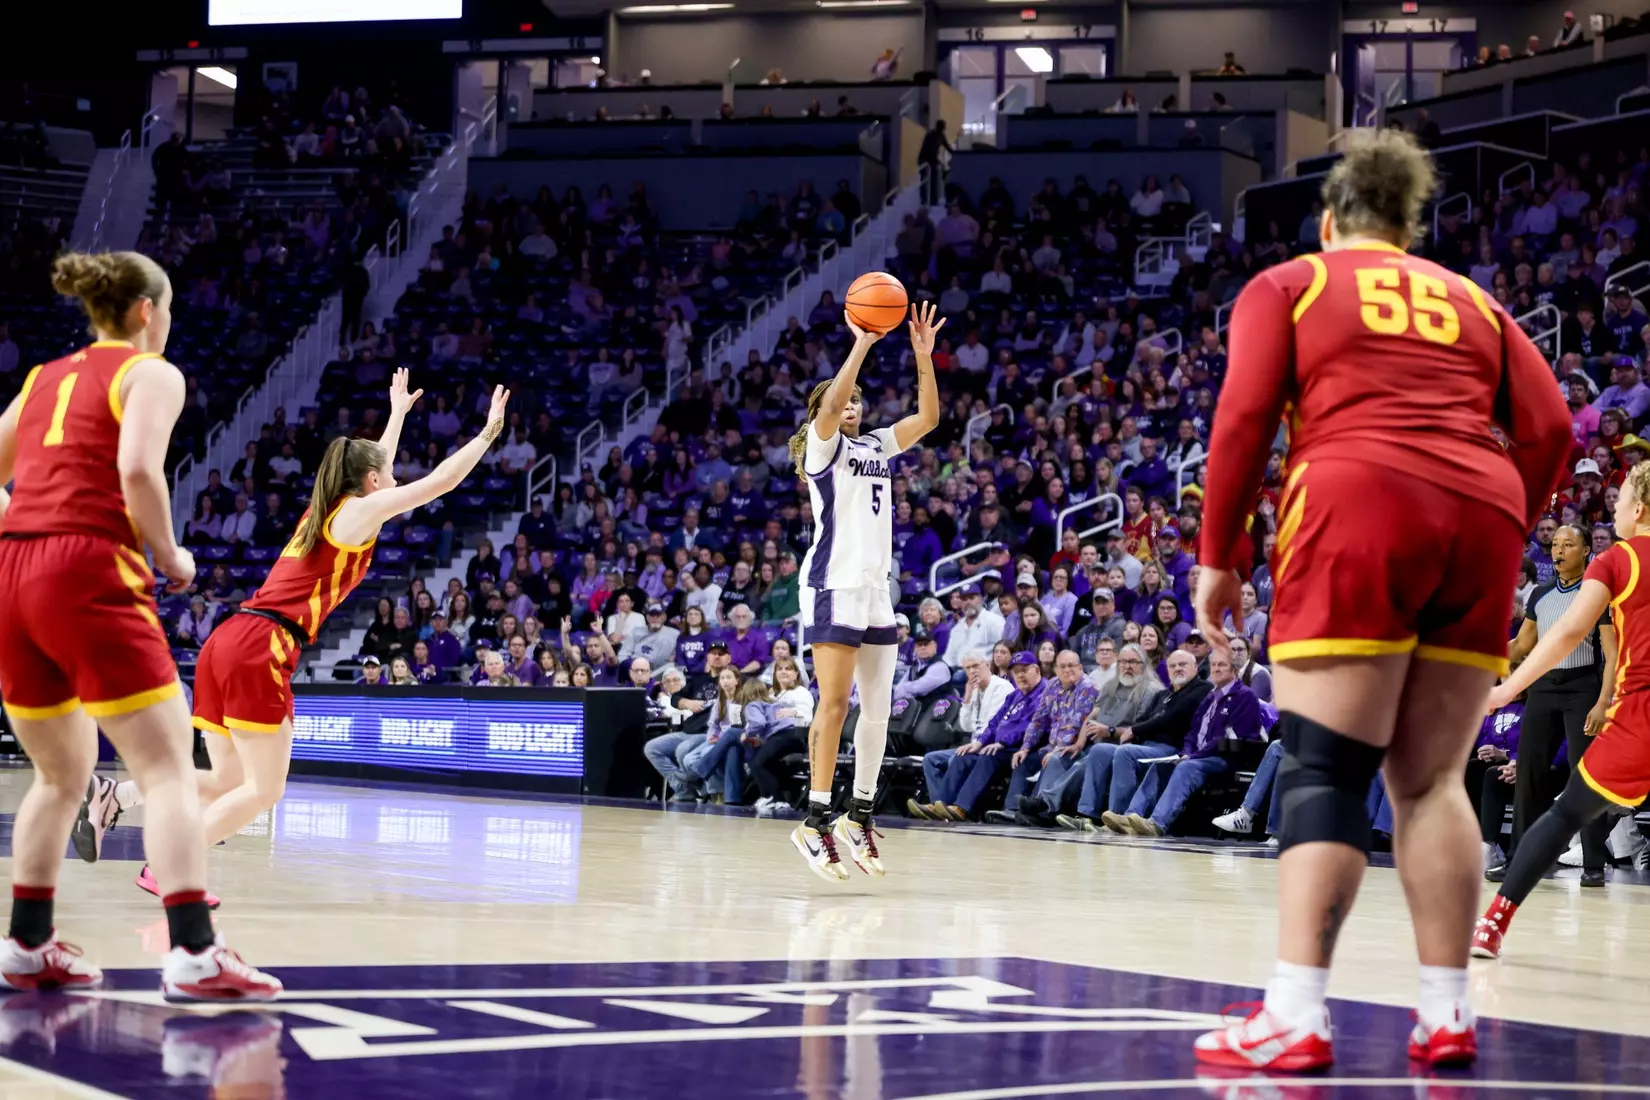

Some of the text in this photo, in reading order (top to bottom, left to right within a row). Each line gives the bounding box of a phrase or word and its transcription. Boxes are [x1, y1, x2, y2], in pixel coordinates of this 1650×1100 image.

[965, 28, 985, 41] 16
[1073, 26, 1092, 39] 17
[1368, 20, 1389, 33] 17
[1428, 18, 1448, 32] 17
[1354, 268, 1461, 346] 55
[42, 371, 79, 447] 1
[871, 483, 883, 516] 5
[292, 715, 352, 742] UD LIGHT
[381, 718, 454, 747] BUD LIGHT
[489, 721, 577, 753] BUD LIGHT
